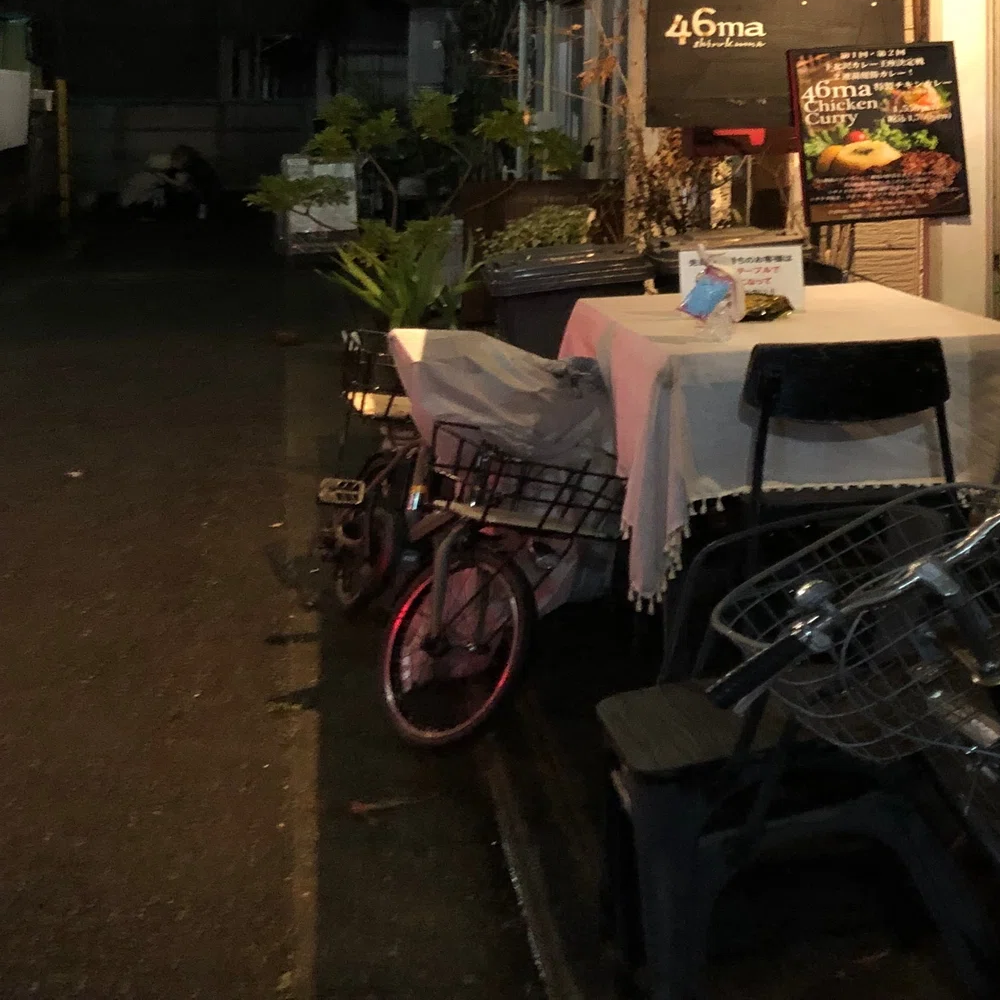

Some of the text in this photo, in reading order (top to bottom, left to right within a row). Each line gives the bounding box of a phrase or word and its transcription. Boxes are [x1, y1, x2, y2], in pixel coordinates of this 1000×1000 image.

[664, 7, 767, 46] 46ma
[801, 80, 873, 104] 46ma
[804, 99, 878, 113] Chicken
[805, 113, 858, 127] Curry
